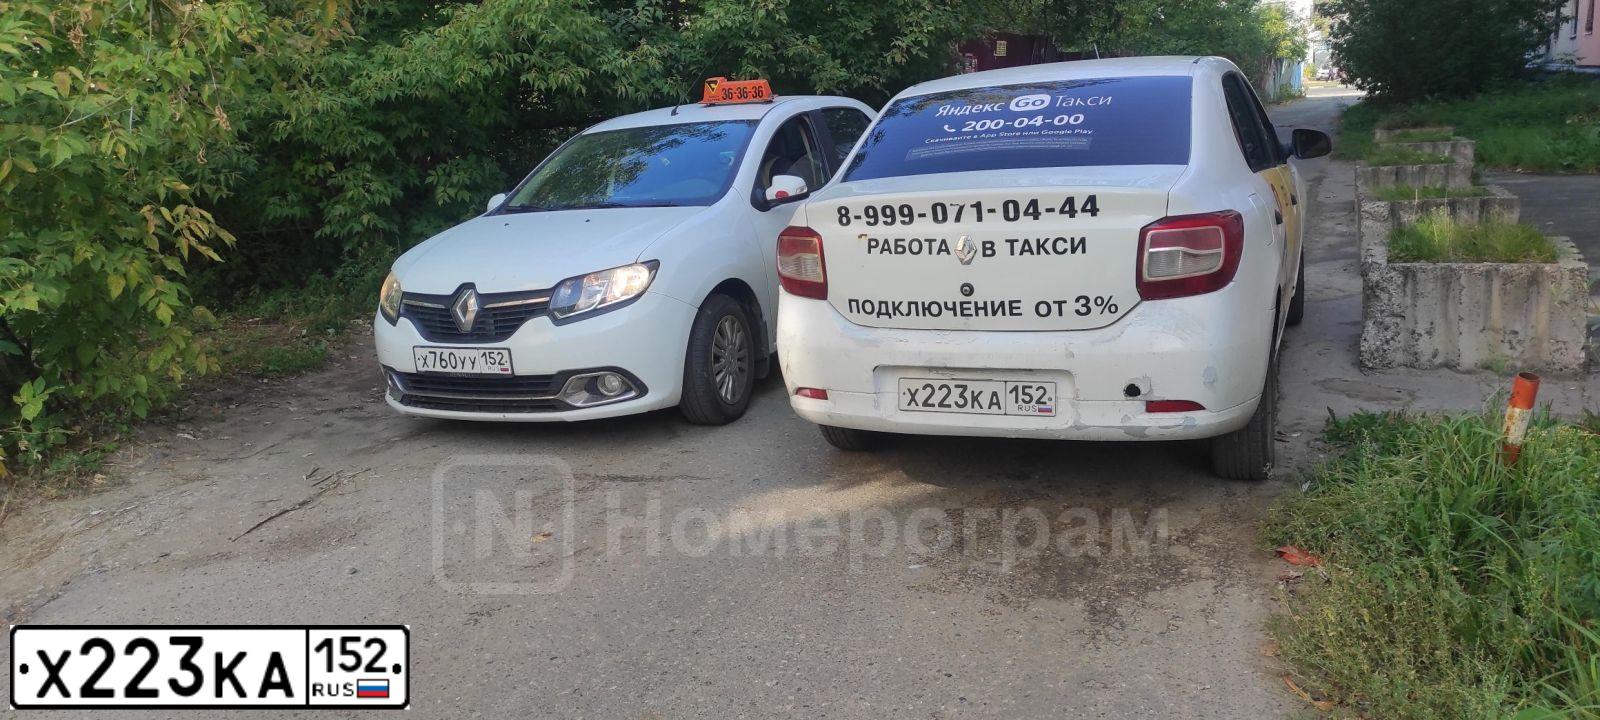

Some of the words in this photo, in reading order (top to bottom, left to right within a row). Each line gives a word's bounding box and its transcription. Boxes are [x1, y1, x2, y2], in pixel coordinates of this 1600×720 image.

[722, 85, 764, 101] 36-36-36
[935, 102, 1006, 117] Яндекс
[1055, 95, 1113, 107] Такси
[961, 113, 1085, 132] 200-04-00
[980, 132, 997, 140] App
[836, 194, 1100, 227] 8-999-071-04-44
[867, 237, 951, 255] РАБОТА
[982, 239, 997, 258] В
[1005, 236, 1087, 256] ТАКСИ
[847, 298, 1023, 319] ПОДКЛЮЧЕНИЕ
[1034, 299, 1068, 318] ОТ
[1074, 295, 1119, 317] 3%
[480, 351, 506, 366] 152
[1008, 384, 1048, 406] 152
[1017, 404, 1038, 413] RUS
